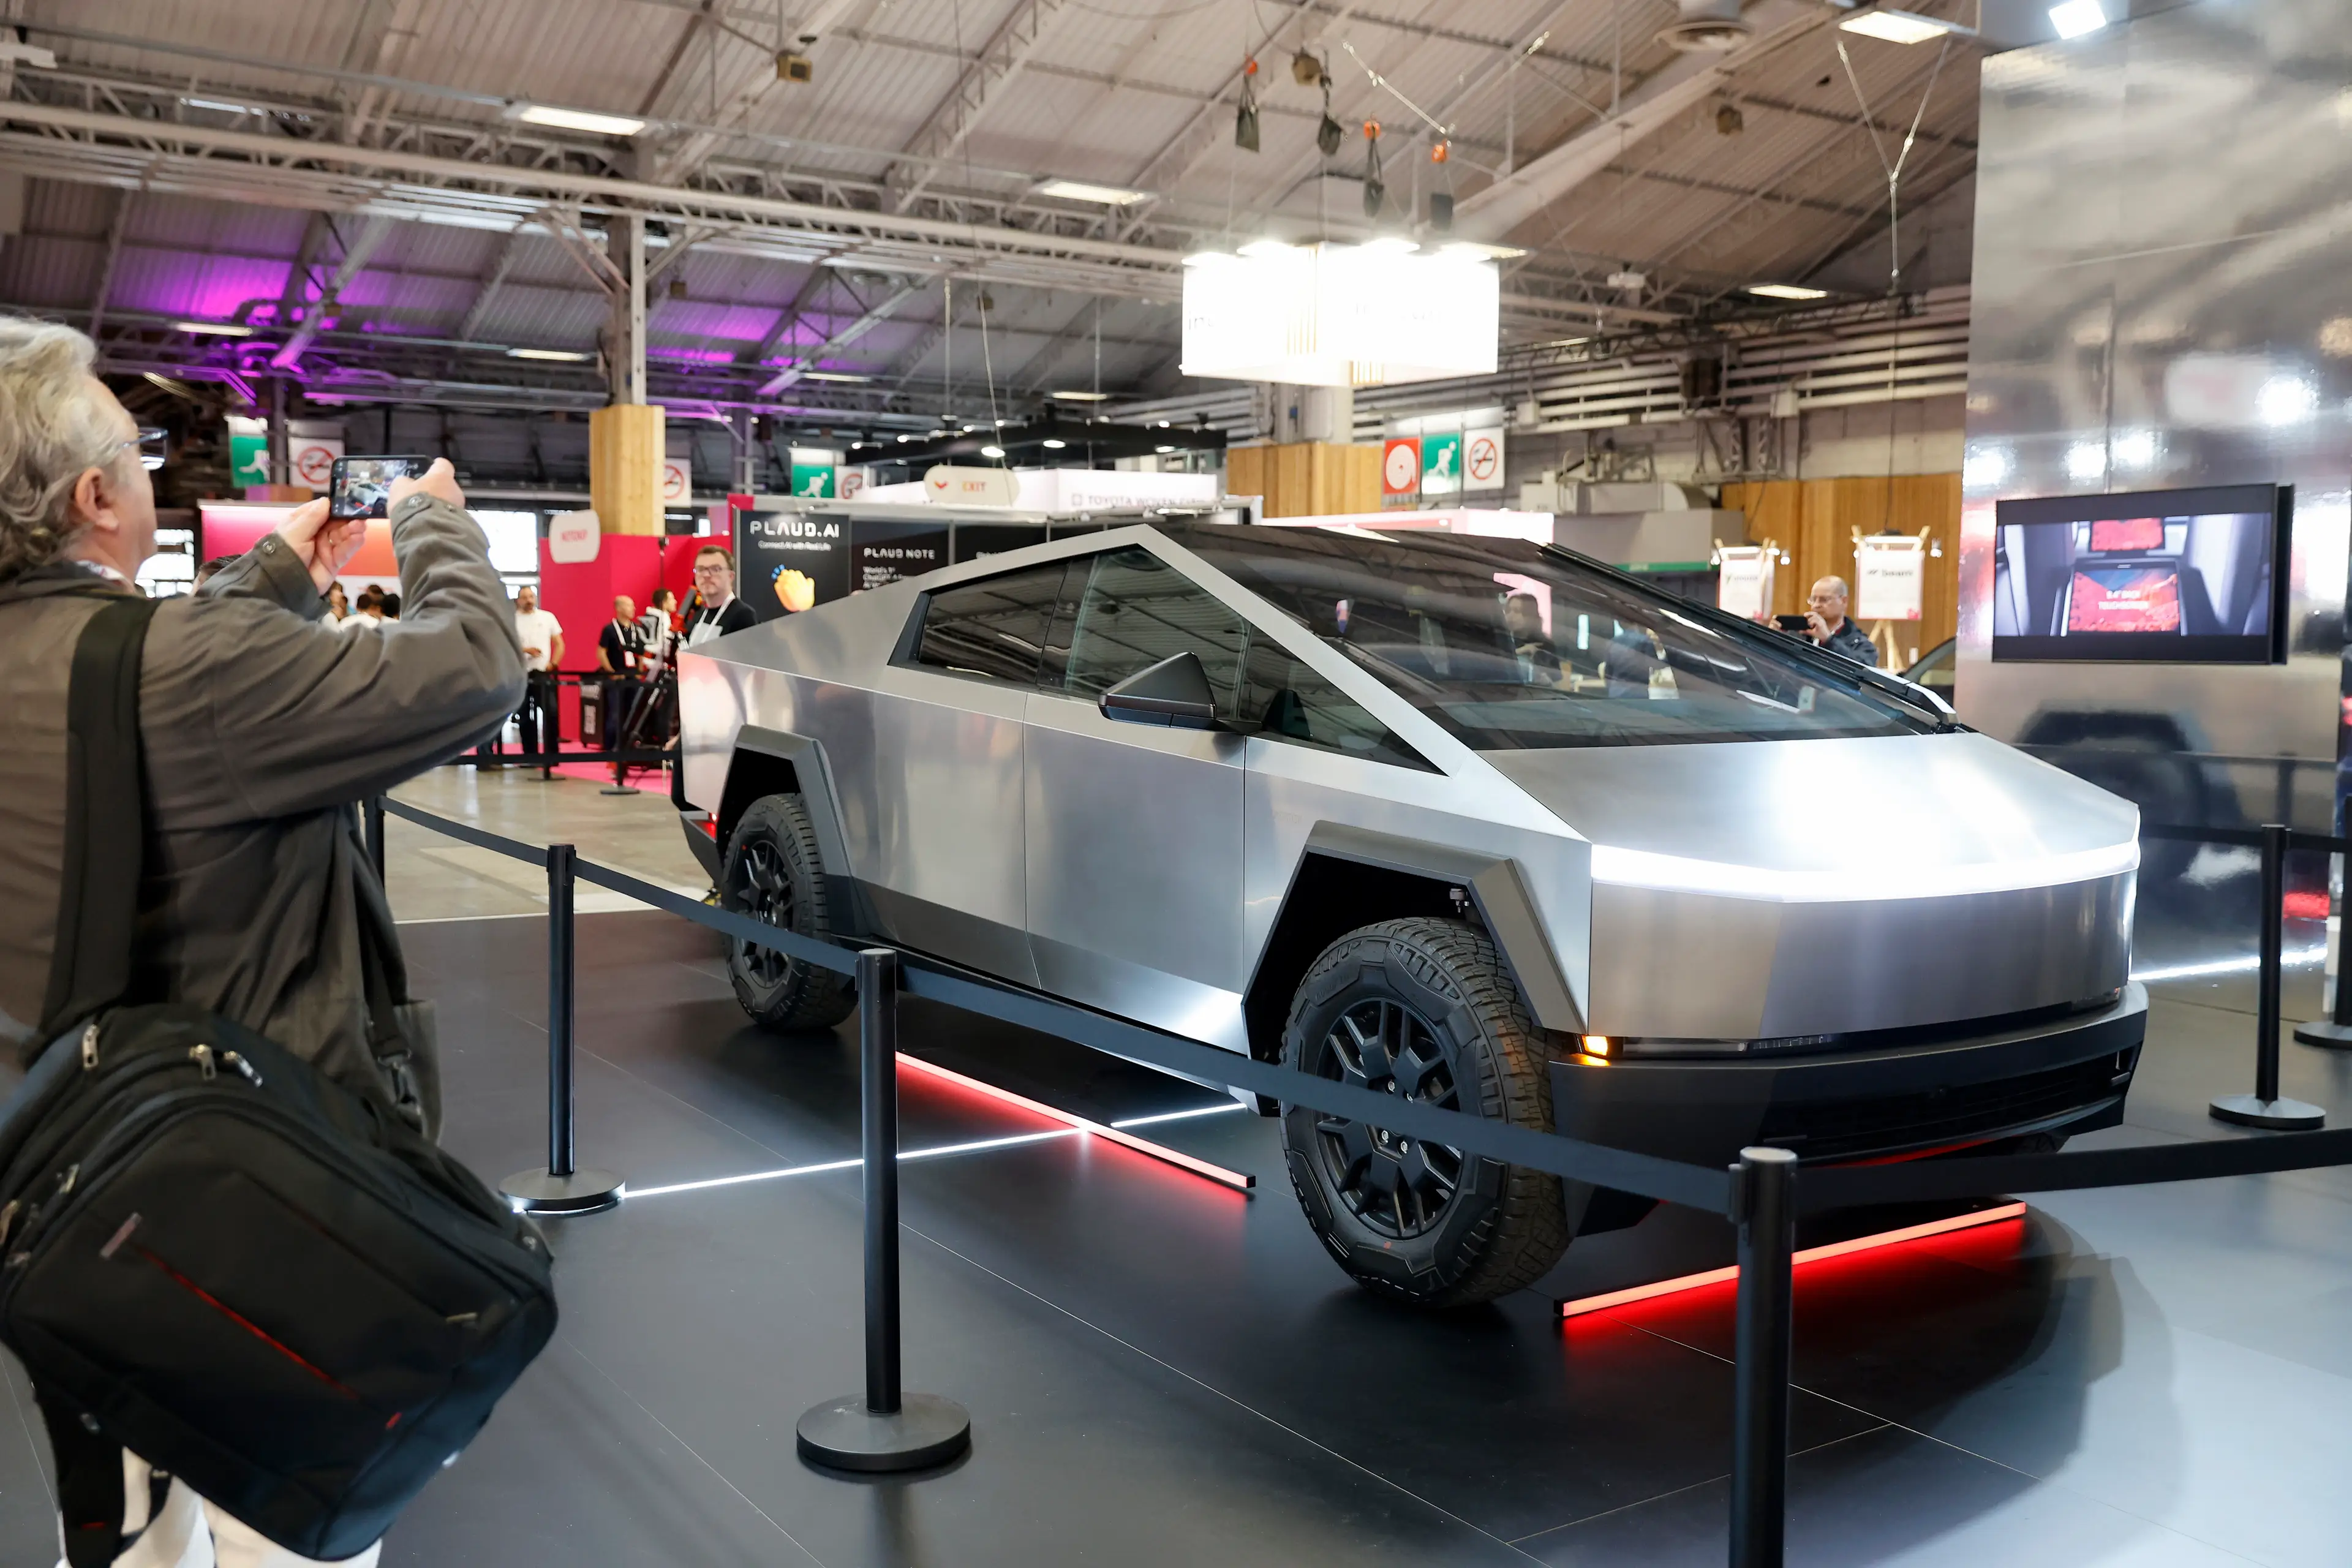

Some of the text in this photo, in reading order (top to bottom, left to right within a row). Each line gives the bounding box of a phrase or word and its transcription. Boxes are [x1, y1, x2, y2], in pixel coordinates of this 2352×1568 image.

[962, 481, 987, 492] EXIT
[1088, 495, 1132, 506] TOYOTA
[750, 520, 840, 538] PLAUD.AI
[864, 548, 935, 560] PLAUD NOTE
